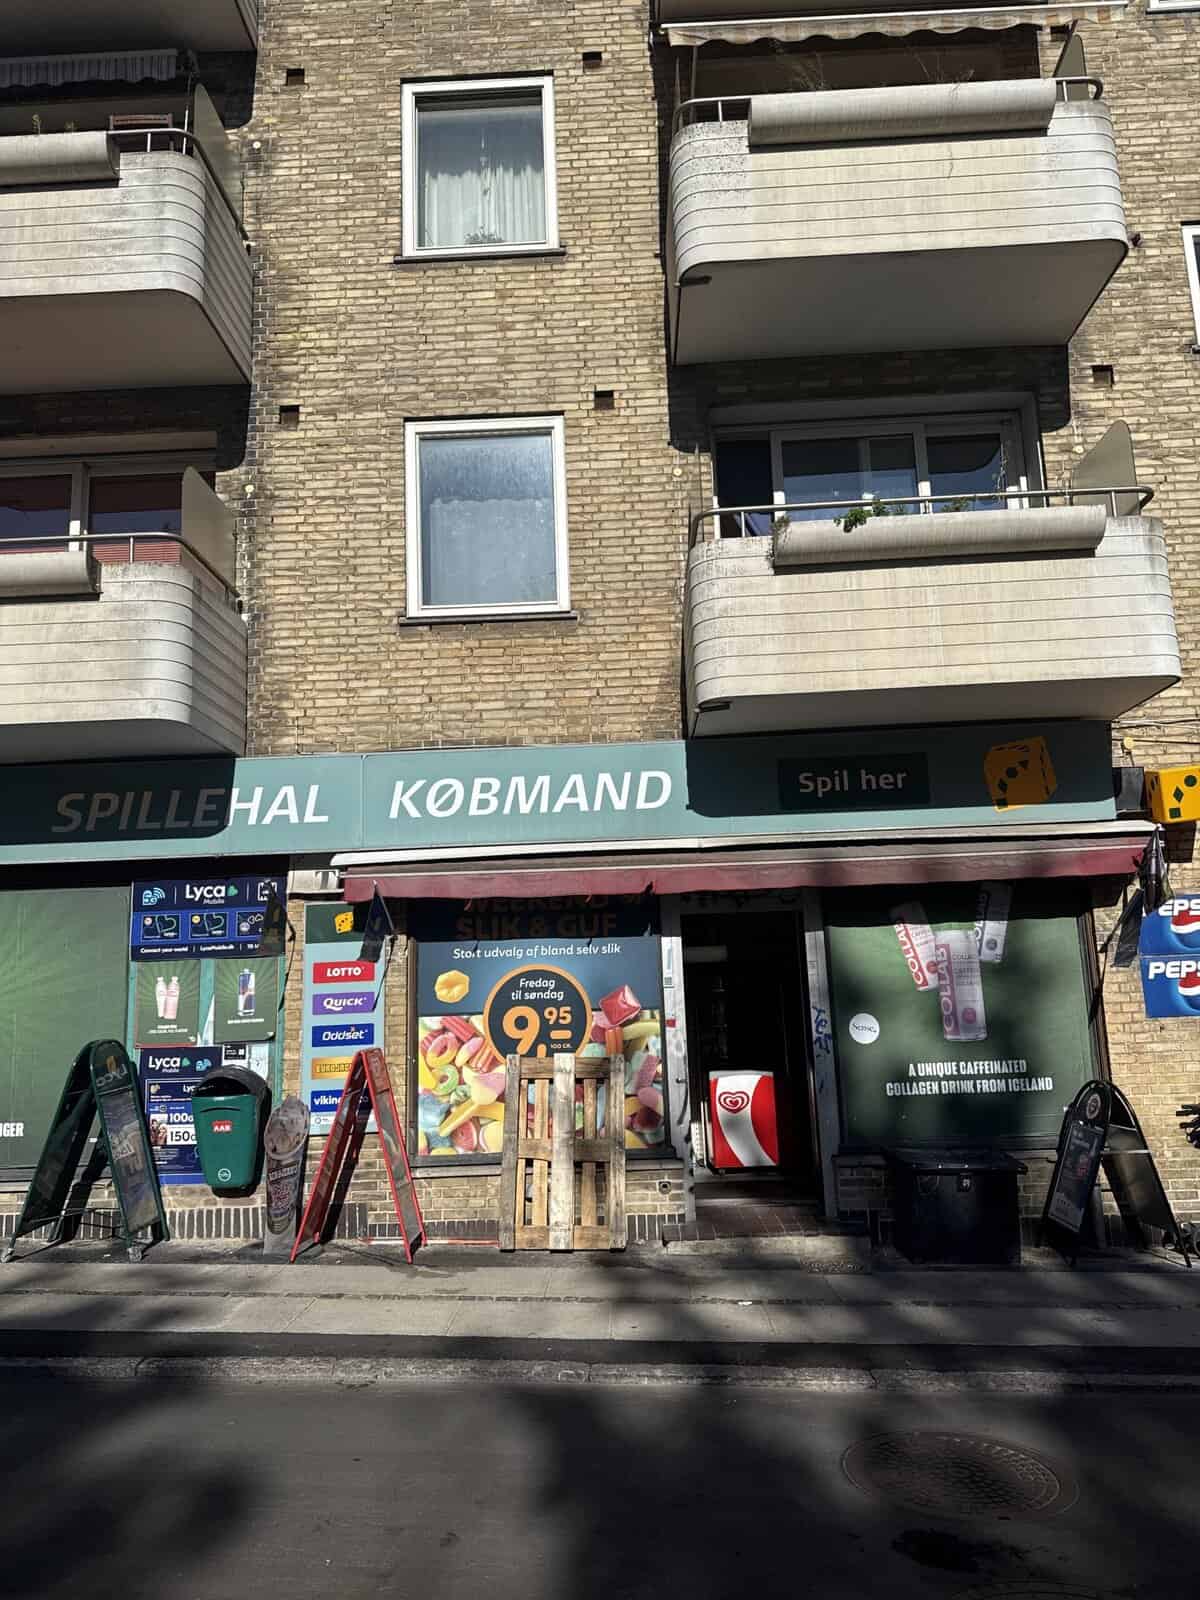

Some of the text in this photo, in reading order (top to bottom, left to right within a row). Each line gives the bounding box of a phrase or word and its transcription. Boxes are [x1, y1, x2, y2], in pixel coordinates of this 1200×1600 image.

[799, 768, 908, 797] Spil her
[389, 769, 672, 819] KØBMAND
[50, 784, 329, 833] SPILLEHAL
[185, 883, 227, 901] Lyca
[456, 914, 521, 939] SLIK
[558, 912, 617, 937] GUF
[452, 943, 621, 960] Stort udvalg af bland selv slik
[326, 966, 362, 977] LOTTO
[1148, 960, 1200, 980] PEP
[519, 977, 556, 990] Fredag
[511, 989, 564, 1001] til søndag
[543, 1006, 572, 1025] 95
[322, 1029, 365, 1041] Oddset
[148, 1055, 181, 1071] Lyca
[908, 1060, 1027, 1078] A UNIQUE CAFFEINATED
[886, 1077, 1054, 1096] COLLAGEN DRINK FROM ICELAND
